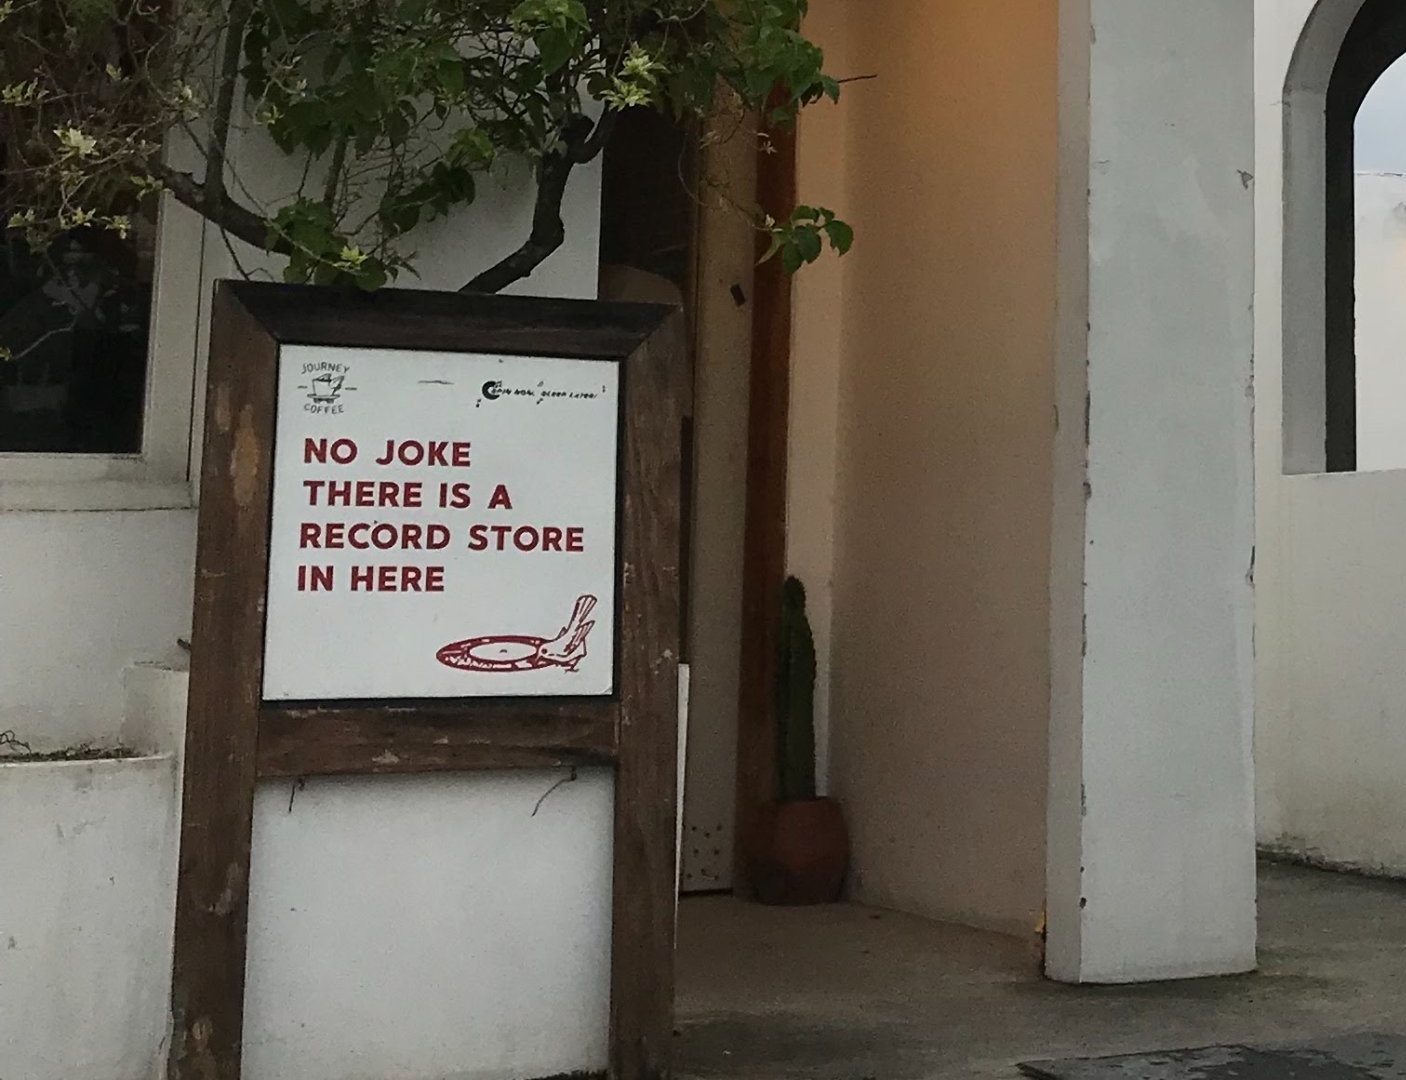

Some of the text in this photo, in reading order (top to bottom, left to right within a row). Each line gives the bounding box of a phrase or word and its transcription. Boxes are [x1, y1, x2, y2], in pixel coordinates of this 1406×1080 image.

[301, 361, 350, 374] JOURNEY
[303, 403, 345, 415] COFFEE
[304, 438, 471, 467] NO JOKE
[303, 480, 512, 509] THERE IS A
[300, 522, 584, 552] RECORD STORE
[298, 565, 444, 592] IN HERE
